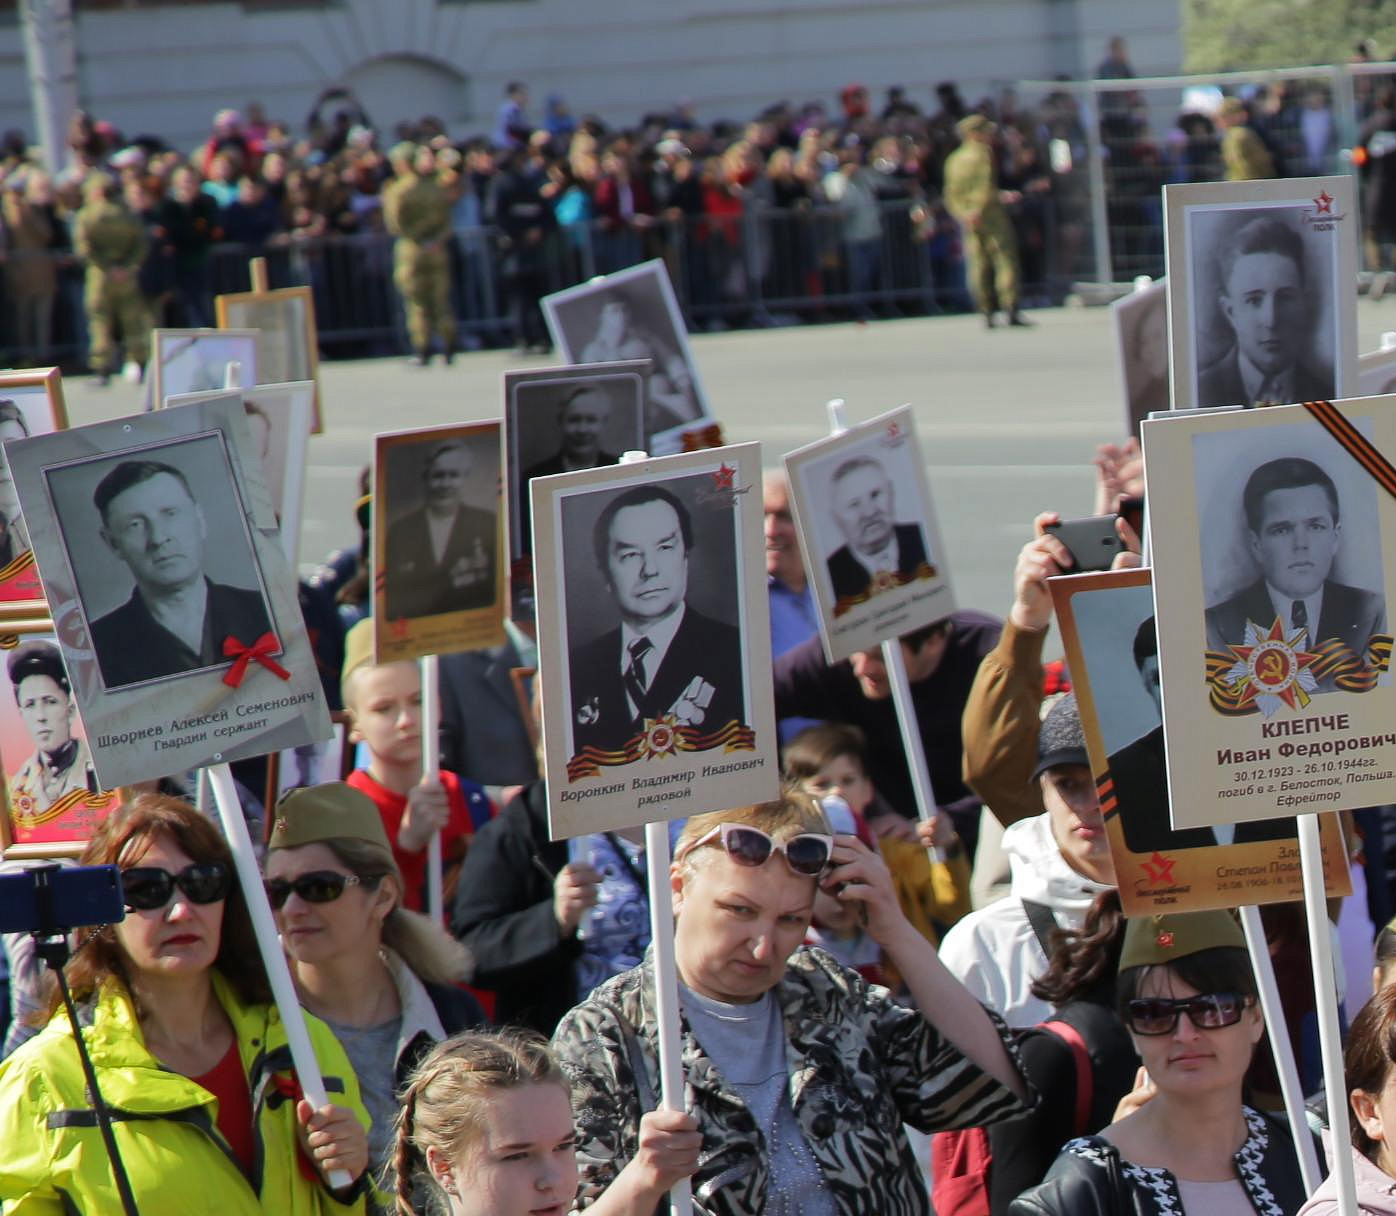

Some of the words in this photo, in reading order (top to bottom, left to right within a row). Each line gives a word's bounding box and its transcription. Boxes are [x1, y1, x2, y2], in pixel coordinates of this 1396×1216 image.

[170, 709, 229, 732] Алексей
[236, 690, 316, 718] Семенович
[154, 732, 207, 752] Гвардии
[213, 718, 268, 739] сержант
[1262, 714, 1350, 739] КЛЕПЧЕ
[1217, 748, 1271, 766] Иван
[1278, 733, 1396, 759] Федорович
[560, 782, 625, 803] Воронкин
[632, 770, 695, 791] Владимир
[702, 757, 765, 778] Иванович
[1218, 784, 1254, 800] погиб
[1257, 786, 1264, 794] в
[1280, 777, 1343, 794] Белосток,
[1346, 771, 1396, 784] Польша.
[1234, 766, 1294, 783] 30.12.1923
[637, 786, 692, 808] рядовой
[1276, 791, 1341, 809] Ефрейтор
[1217, 863, 1267, 878] Степан
